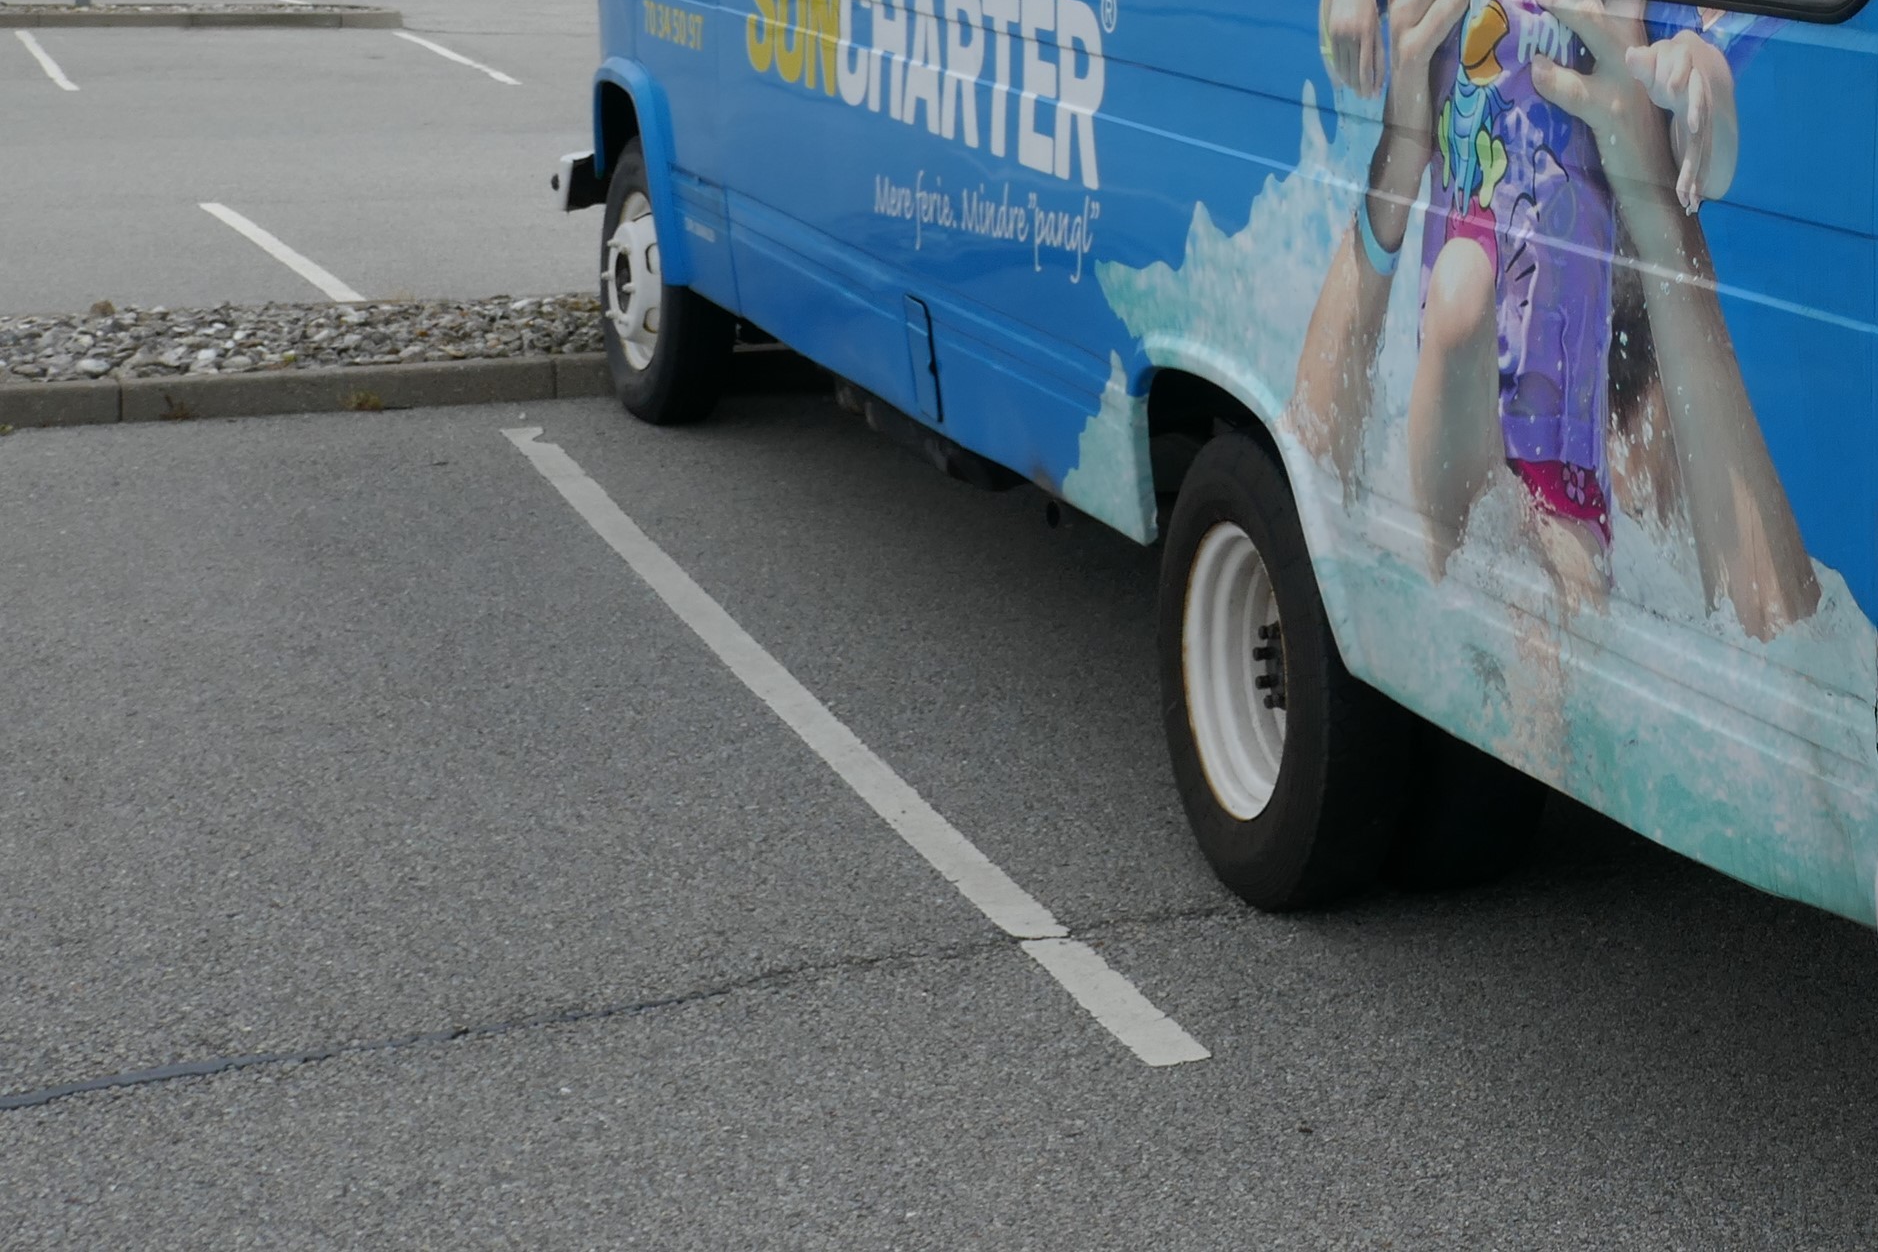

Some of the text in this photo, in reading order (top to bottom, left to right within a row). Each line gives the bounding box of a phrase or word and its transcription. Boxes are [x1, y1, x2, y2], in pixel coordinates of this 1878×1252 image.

[873, 174, 915, 220] Mere
[914, 169, 957, 251] ferie.
[961, 181, 1030, 243] Mindre
